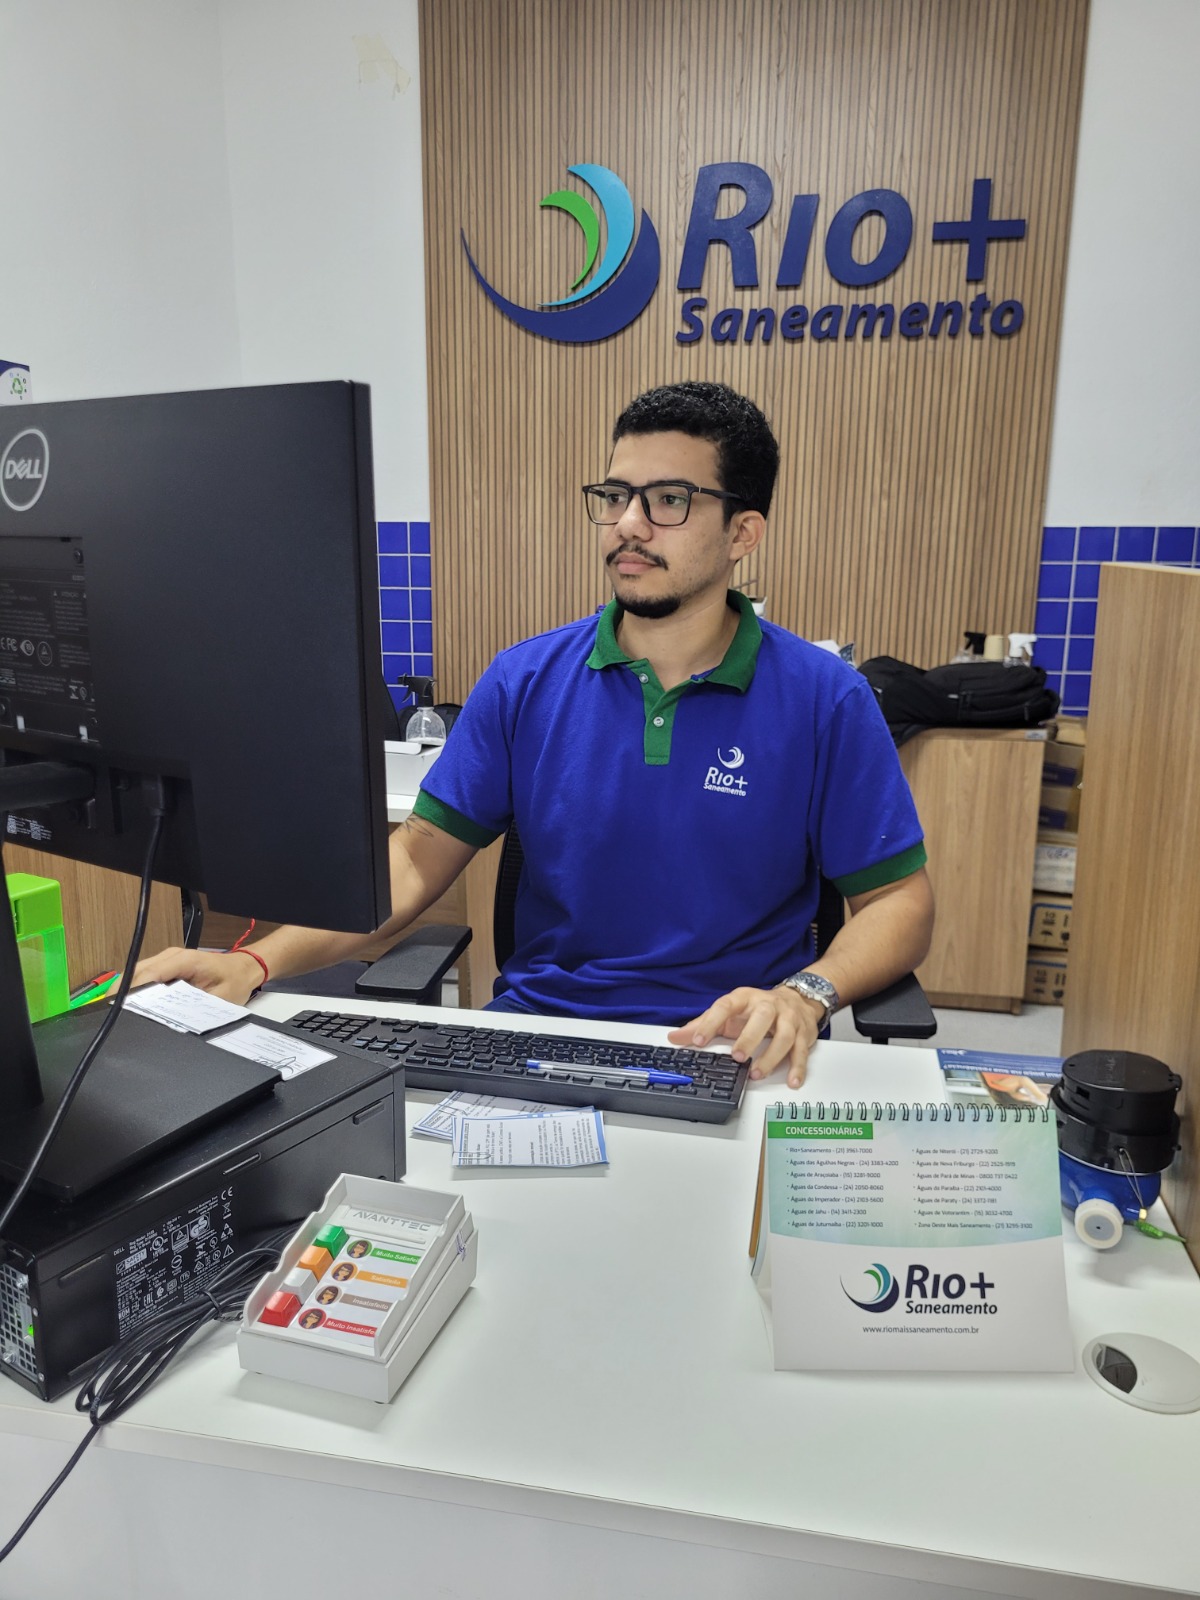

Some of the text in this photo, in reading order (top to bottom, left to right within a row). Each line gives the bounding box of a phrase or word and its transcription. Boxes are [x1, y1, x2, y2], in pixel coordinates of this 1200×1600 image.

[676, 293, 1023, 343] Saneamento
[5, 458, 42, 480] DELL
[703, 782, 746, 796] Saneamento
[786, 1126, 863, 1135] CONCESSIONÁRIAS
[353, 1211, 431, 1231] AVANTTEC
[113, 1246, 125, 1256] DELL
[126, 1251, 146, 1263] SAFETY
[376, 1250, 418, 1263] Muito Satisfei
[370, 1275, 401, 1285] Satisfeito
[353, 1298, 389, 1310] Insatisfeito
[906, 1300, 998, 1314] Saneamento
[327, 1321, 375, 1334] Muito Insatisfe
[862, 1326, 979, 1334] www.riomaissaneamento.com.br
